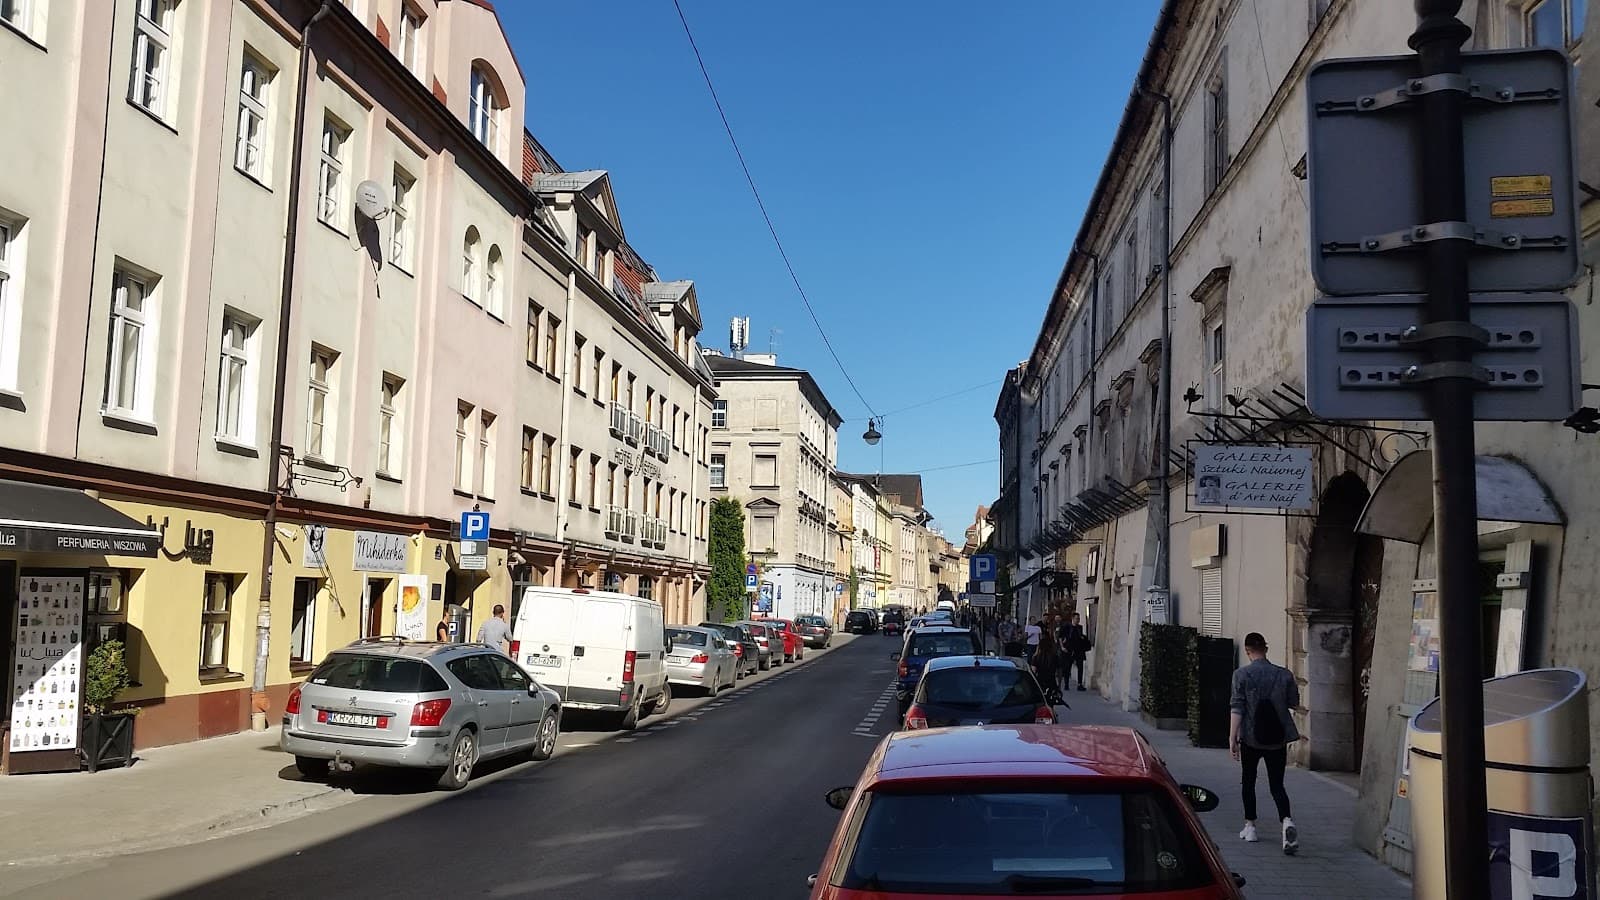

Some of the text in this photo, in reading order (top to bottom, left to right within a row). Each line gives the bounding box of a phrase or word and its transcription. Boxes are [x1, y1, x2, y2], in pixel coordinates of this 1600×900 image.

[1213, 452, 1292, 462] GALERIA
[1250, 465, 1307, 480] Naiwnej
[1225, 481, 1305, 491] GALERIE
[1269, 493, 1297, 507] Naif
[467, 515, 484, 537] P
[57, 536, 147, 552] PERFUMERIA NISZOWA
[975, 557, 990, 577] P
[1509, 828, 1577, 900] P
